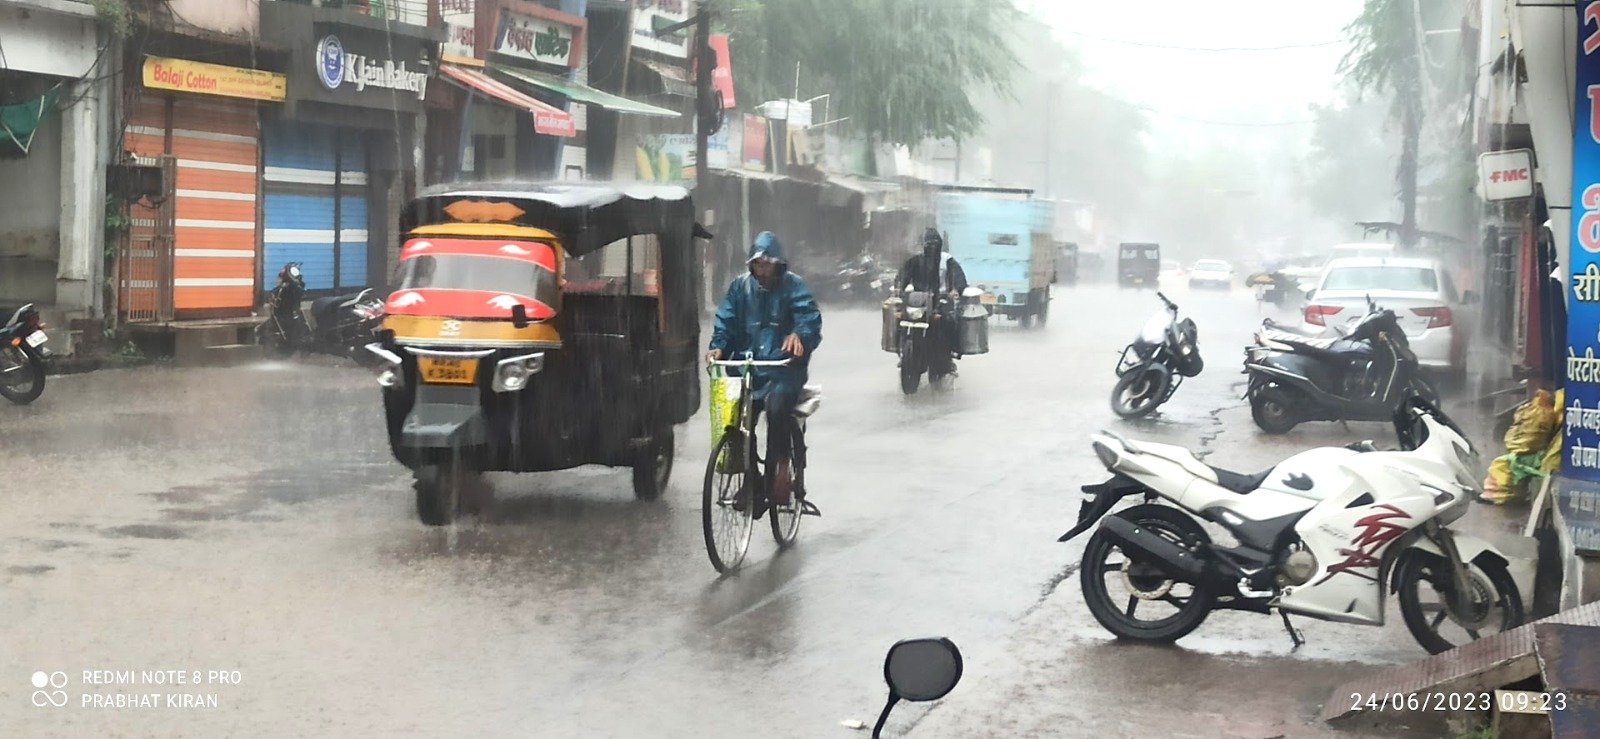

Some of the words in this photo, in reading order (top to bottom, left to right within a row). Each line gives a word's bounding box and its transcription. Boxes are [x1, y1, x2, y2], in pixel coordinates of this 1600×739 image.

[154, 63, 183, 88] Balaji
[186, 70, 217, 90] Cotton
[344, 53, 358, 83] K
[356, 55, 386, 92] Jain
[383, 60, 428, 101] Bakery
[1489, 168, 1528, 183] FMC
